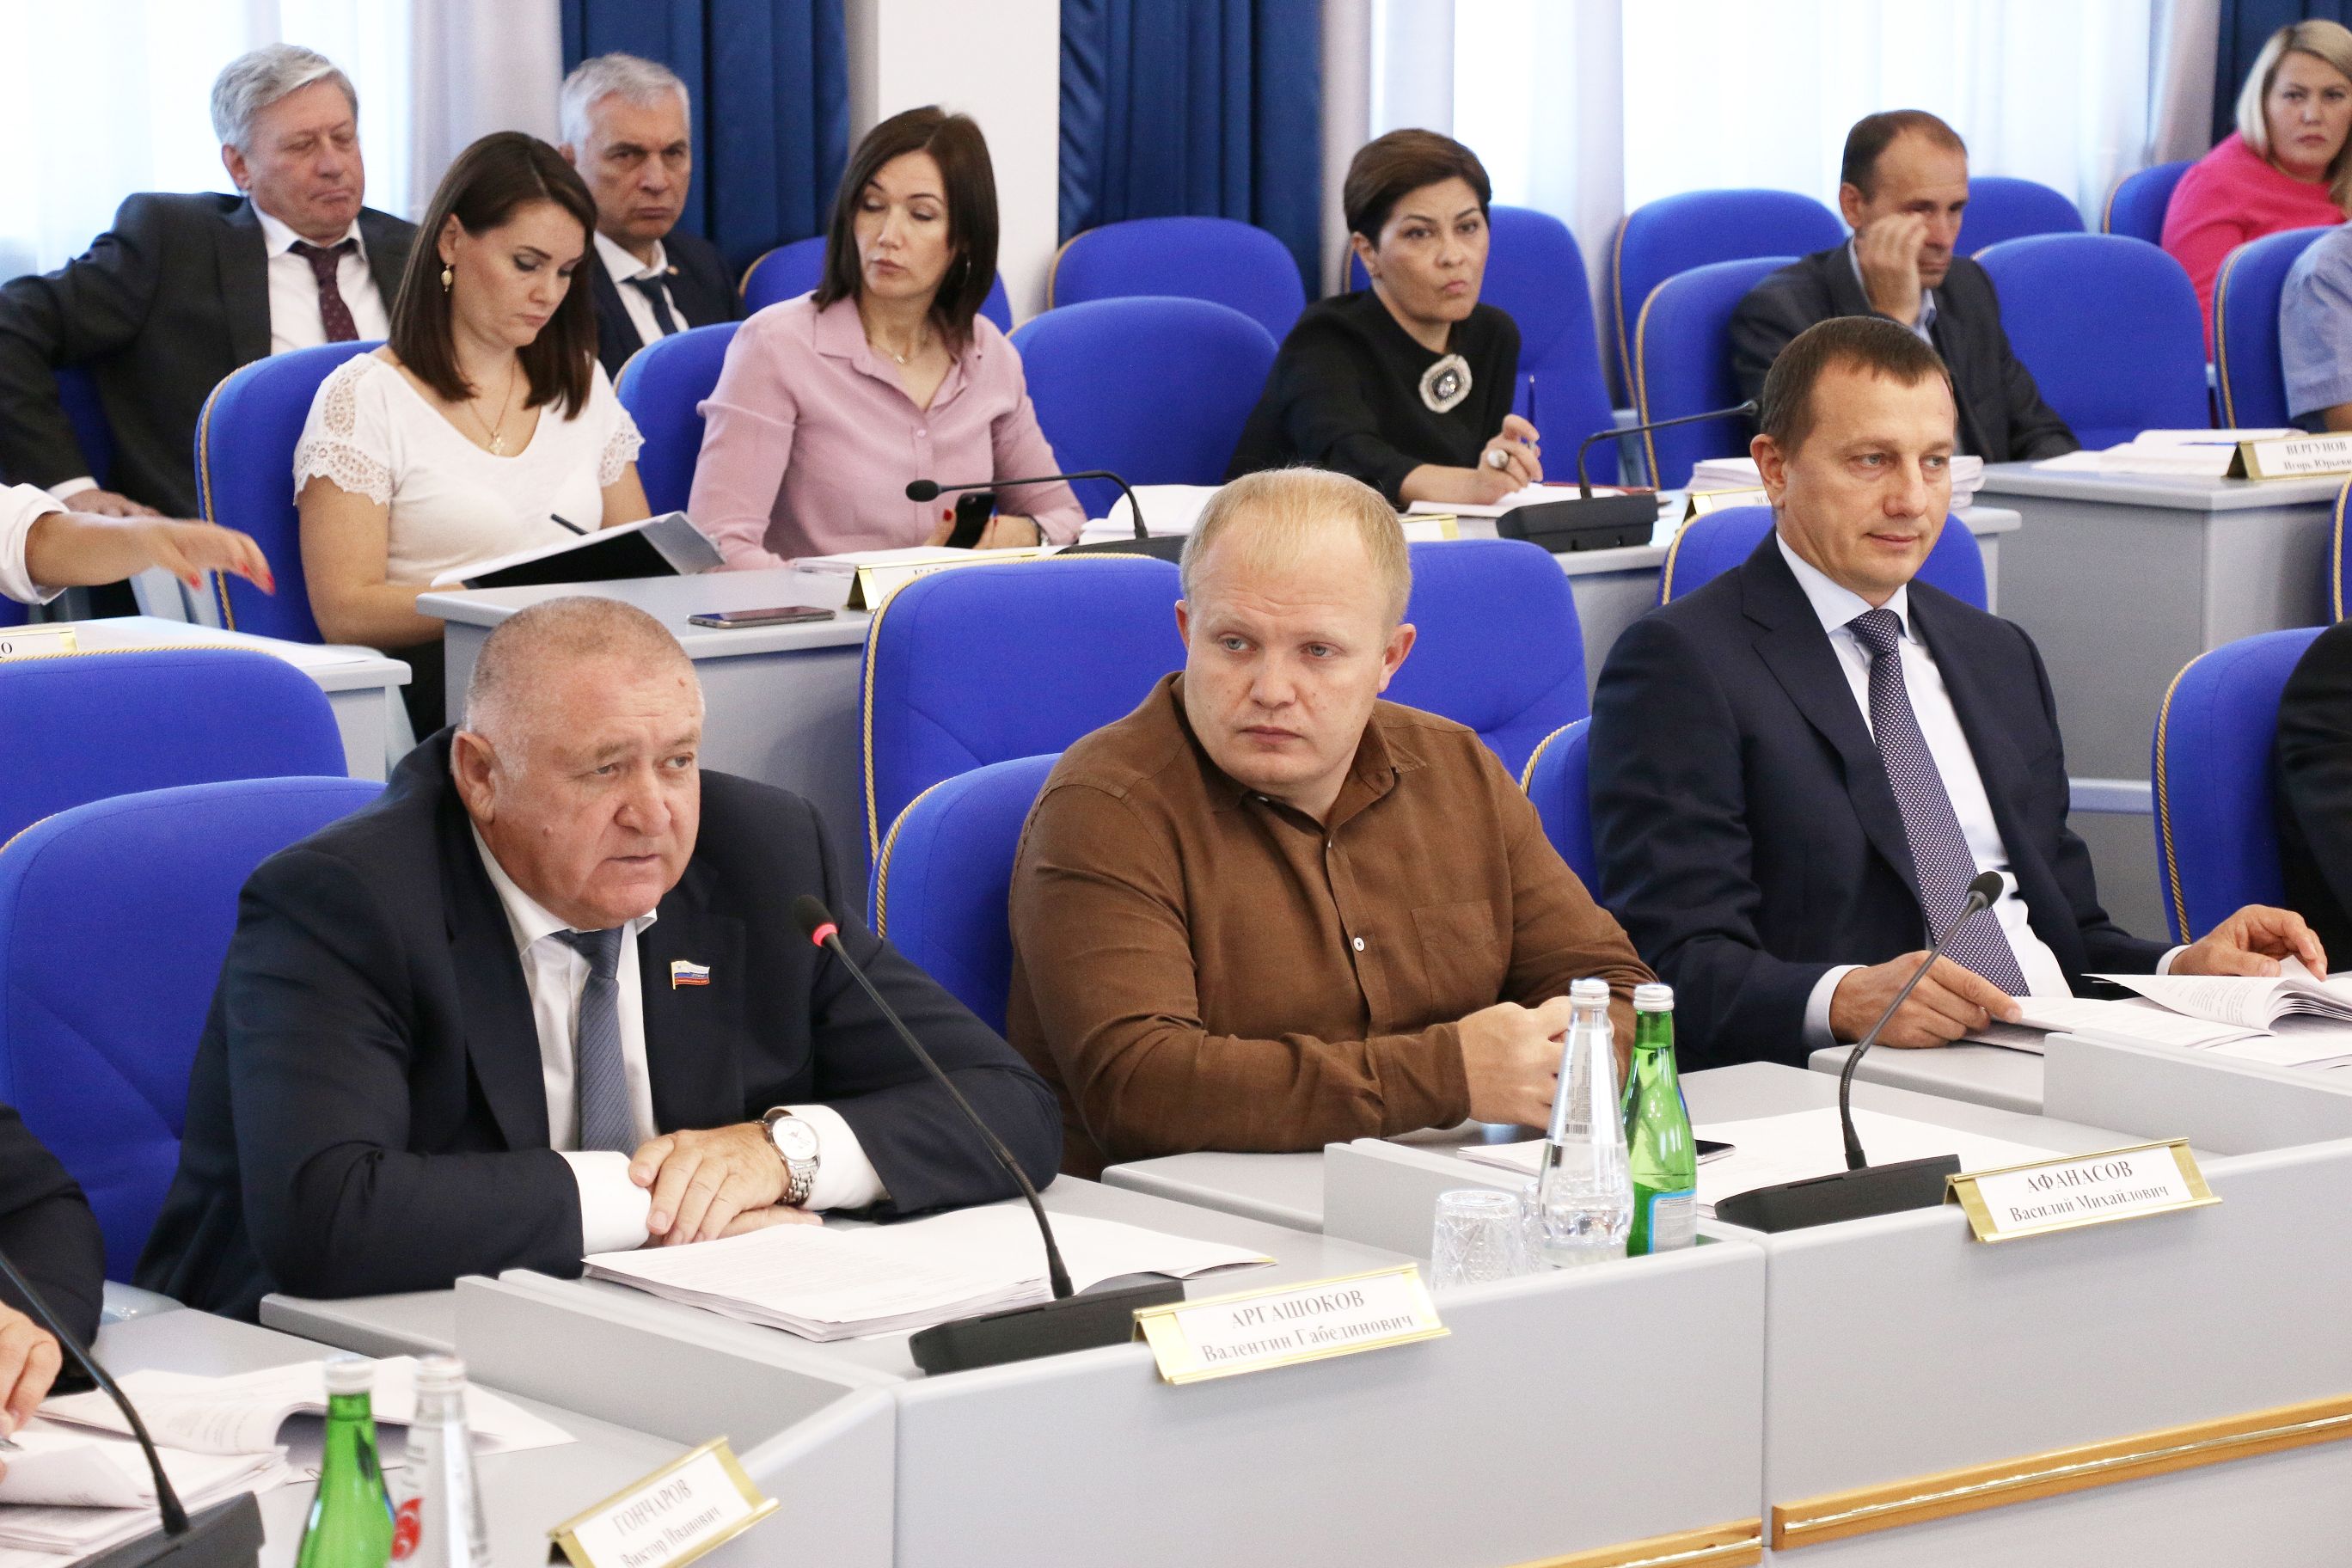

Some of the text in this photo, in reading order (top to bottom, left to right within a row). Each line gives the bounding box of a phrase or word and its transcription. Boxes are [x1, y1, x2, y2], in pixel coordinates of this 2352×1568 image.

[2027, 1161, 2134, 1194] АФАНАСОВ
[2010, 1185, 2169, 1222] Василий Михайлович
[1231, 1289, 1366, 1329] АРГАШОКОВ
[1202, 1336, 1293, 1363] Валентин
[613, 1479, 692, 1536] ГОНЧАРОВ
[620, 1506, 722, 1568] Виктор Иванович
